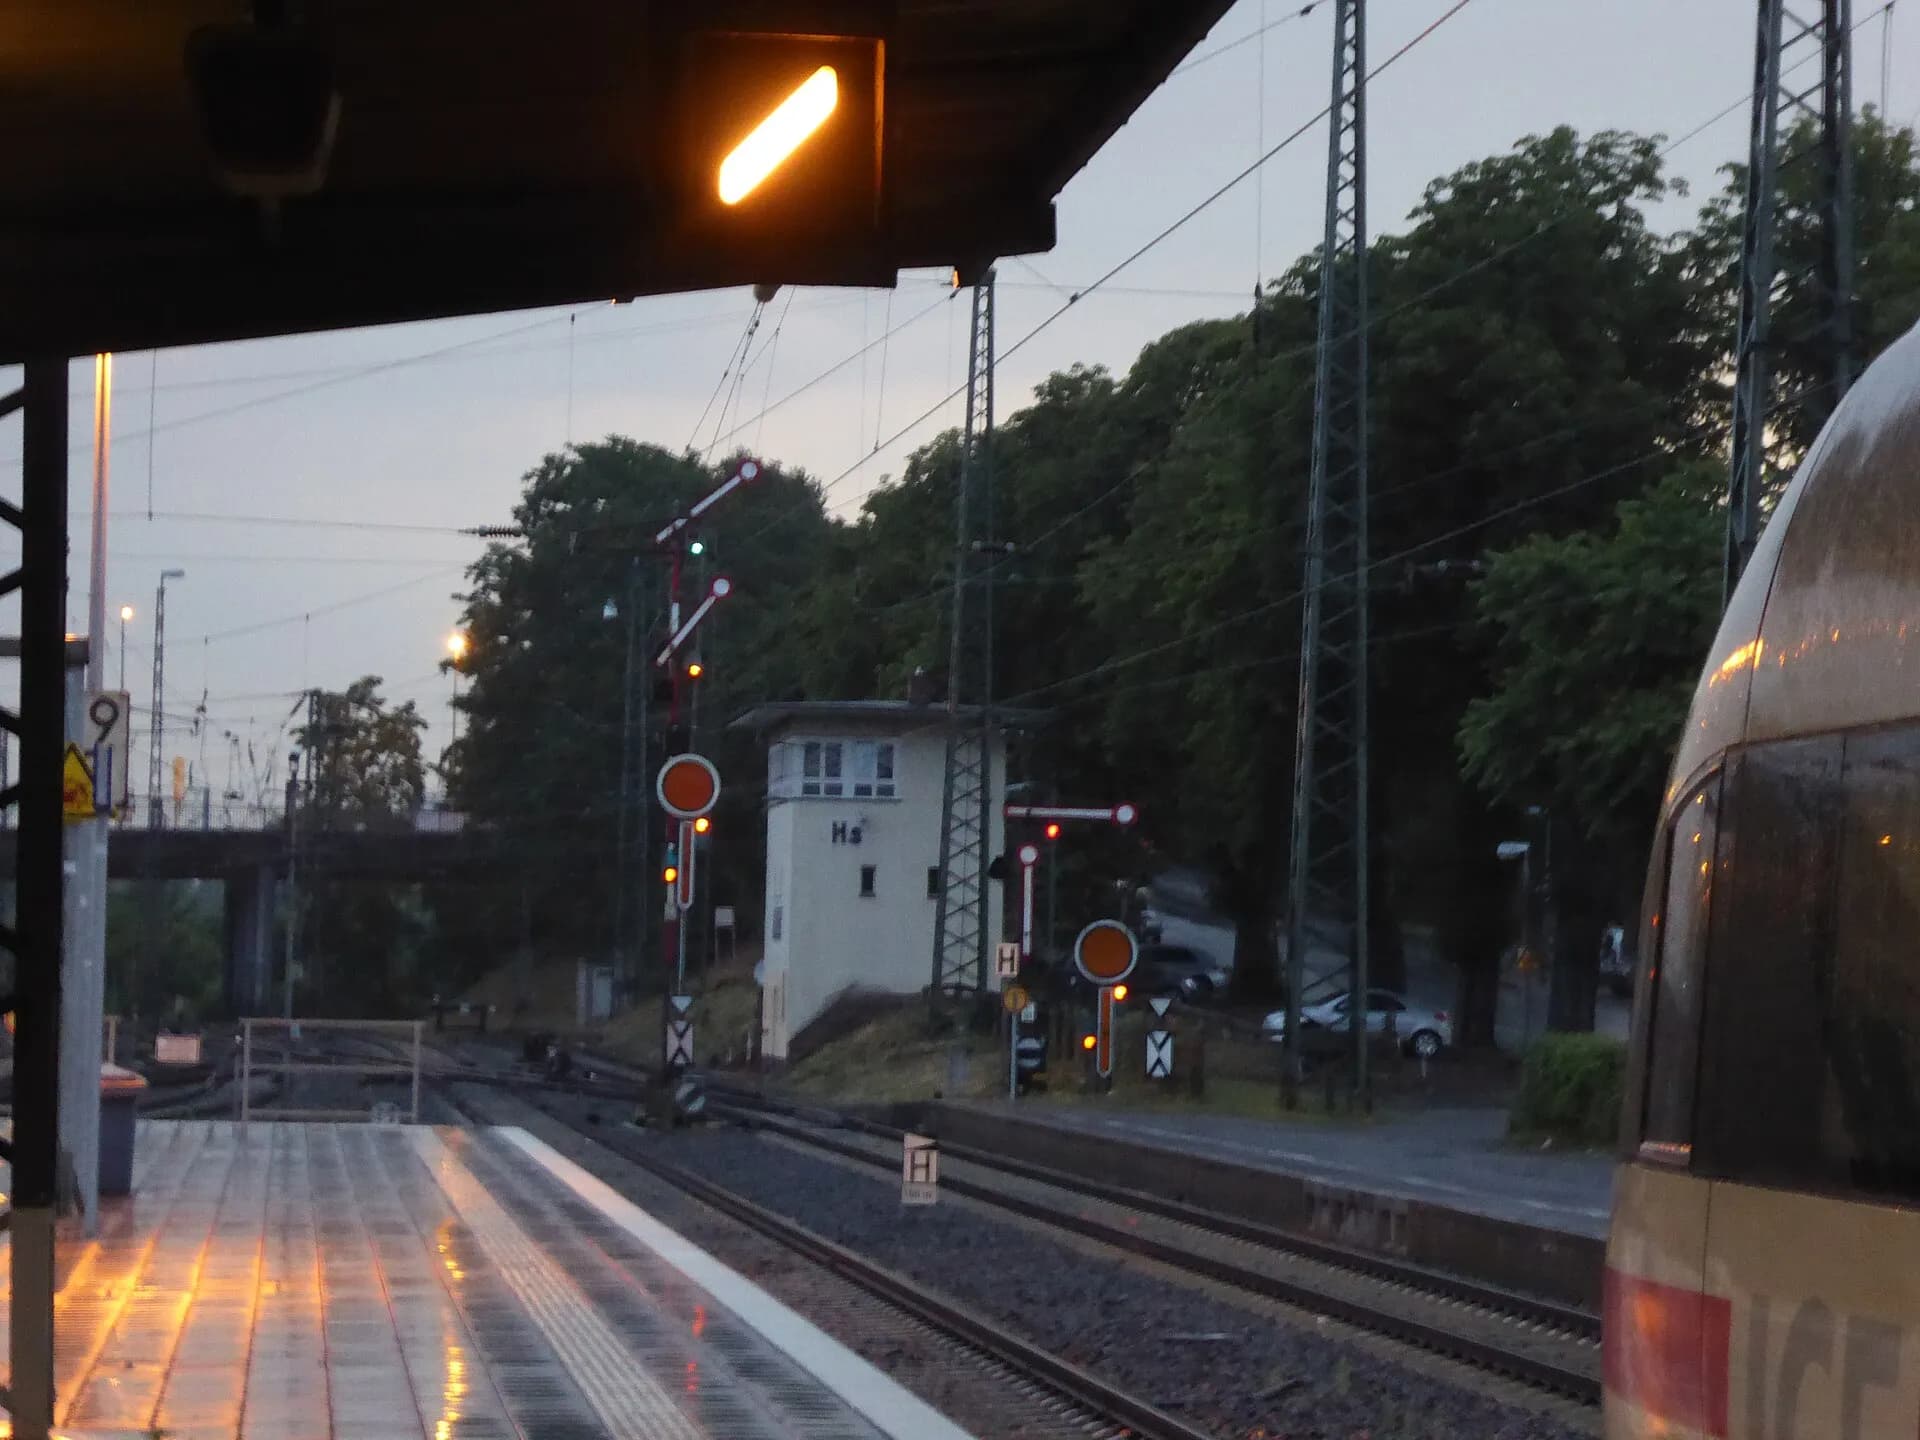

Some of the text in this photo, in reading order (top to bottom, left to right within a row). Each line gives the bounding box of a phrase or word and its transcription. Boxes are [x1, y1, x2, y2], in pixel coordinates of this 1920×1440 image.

[89, 697, 119, 743] 9
[997, 946, 1015, 973] H
[910, 1150, 929, 1183] H
